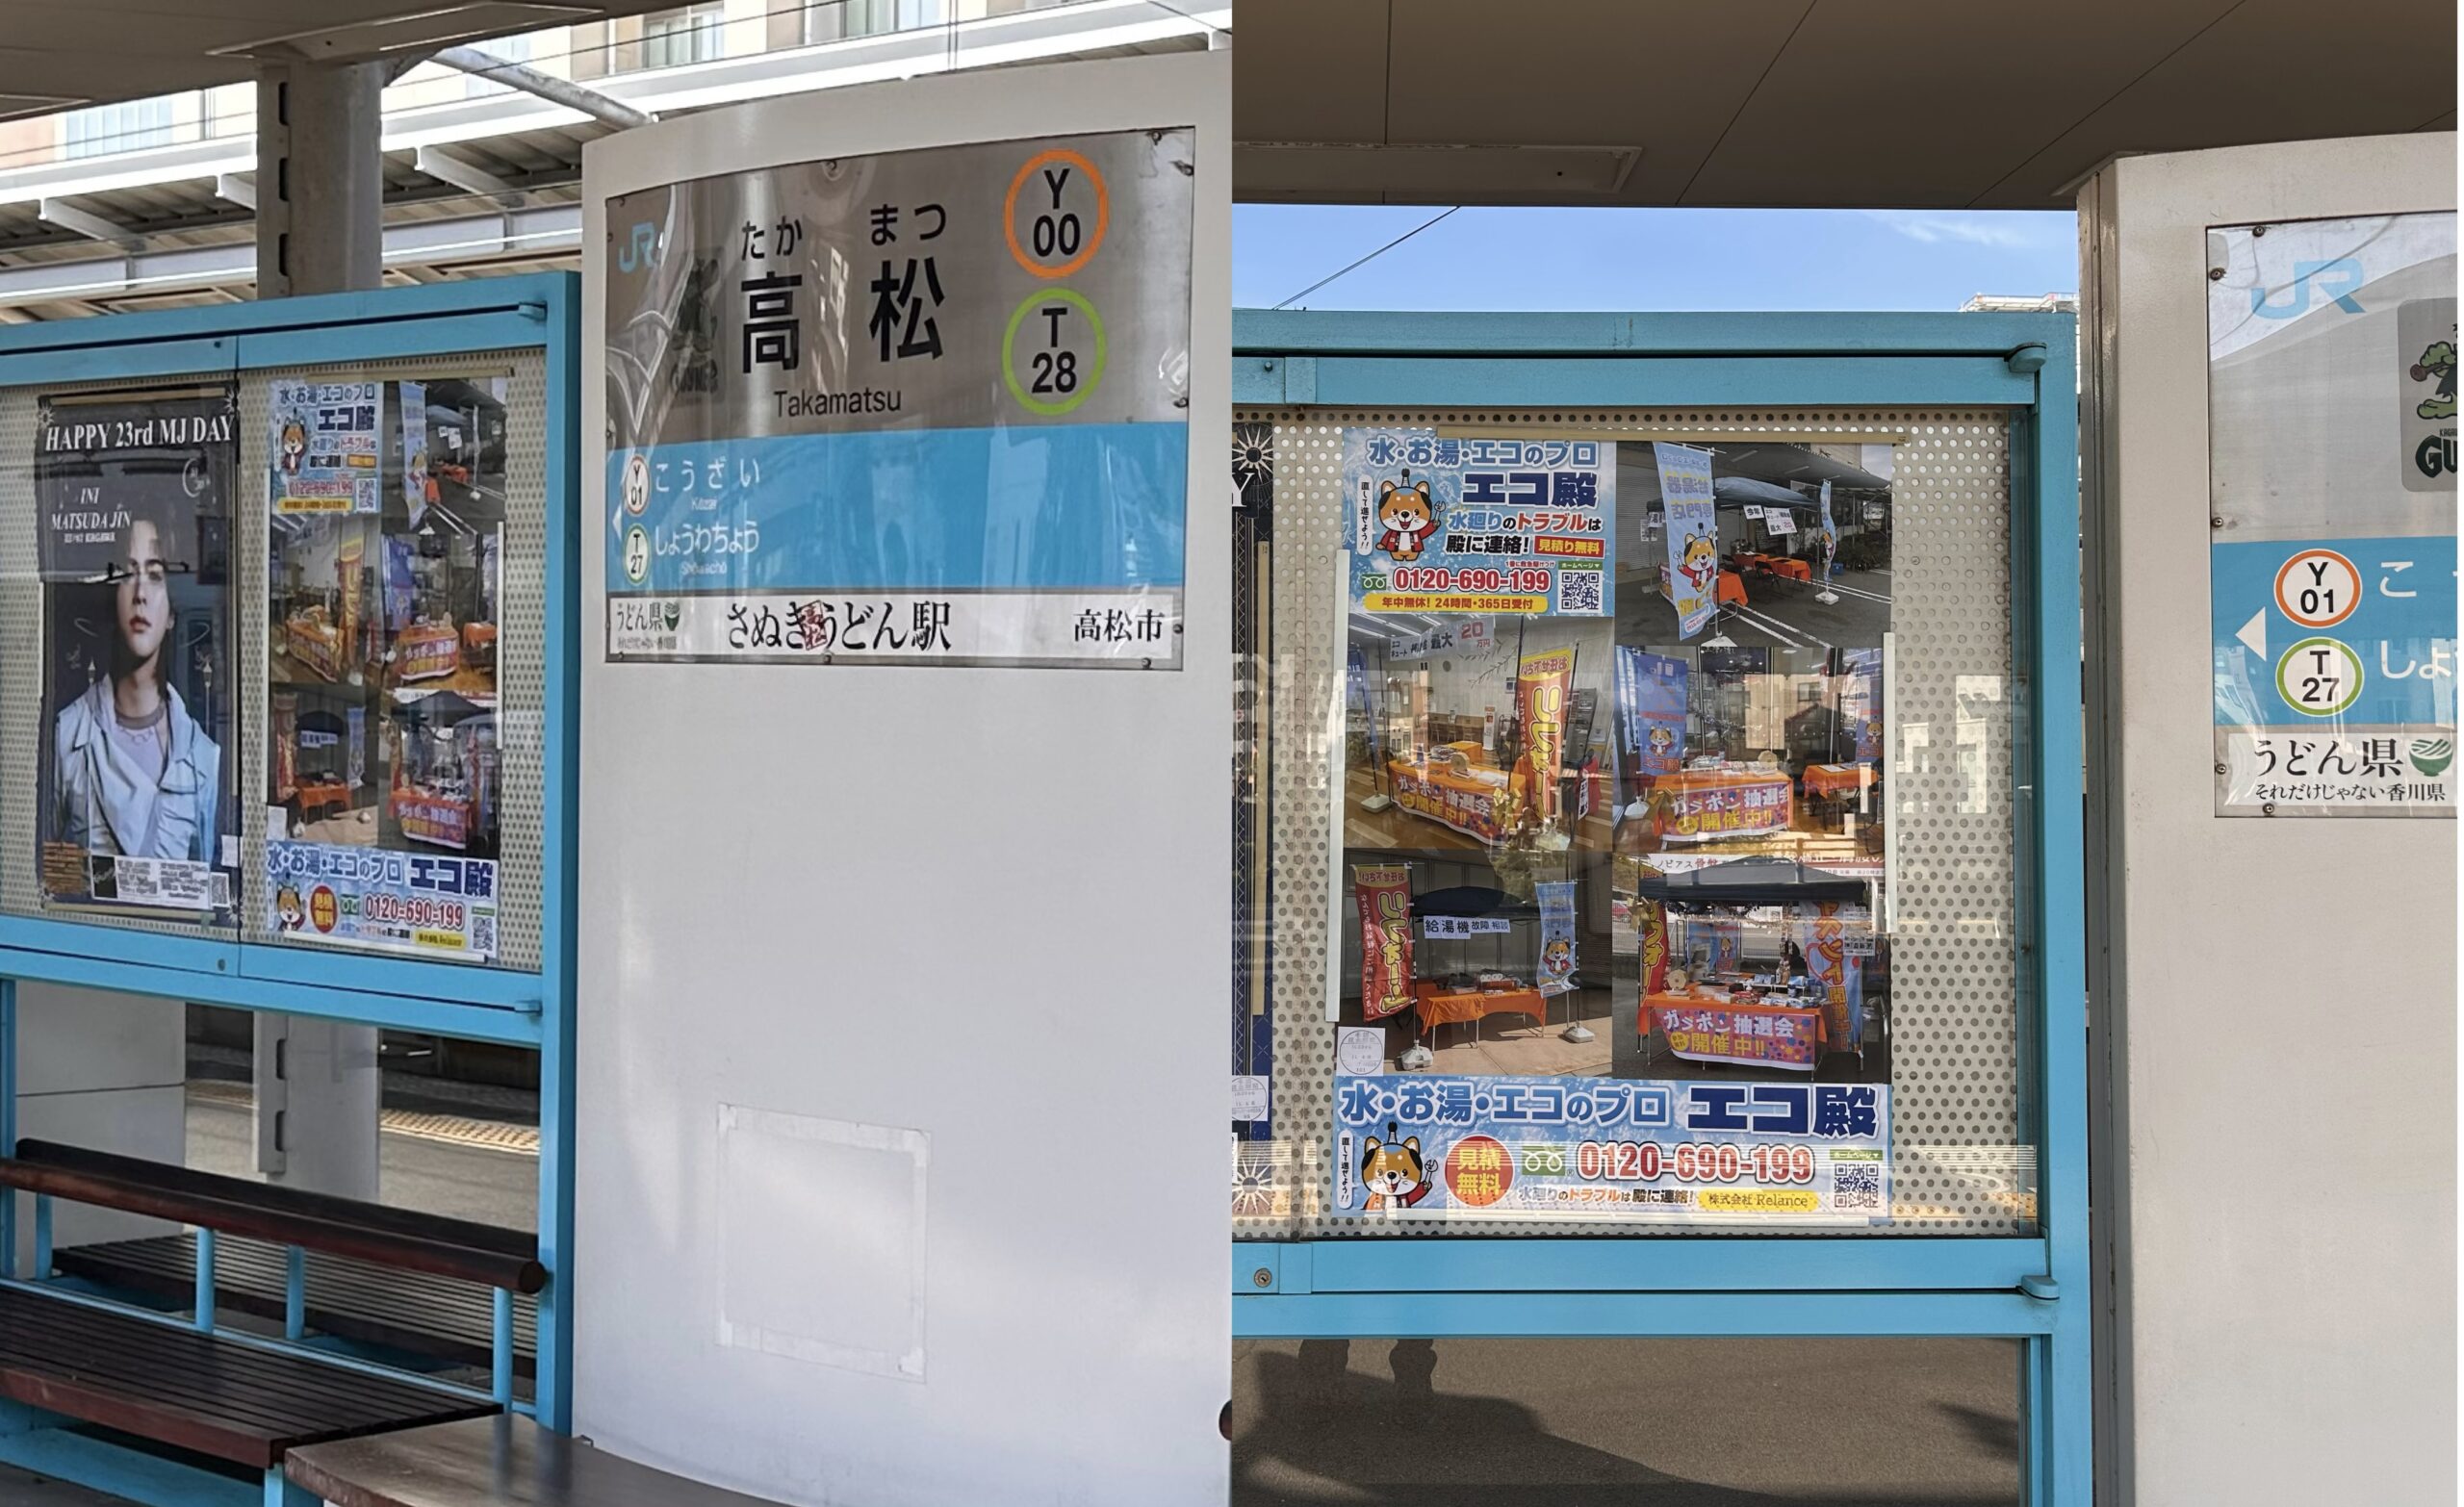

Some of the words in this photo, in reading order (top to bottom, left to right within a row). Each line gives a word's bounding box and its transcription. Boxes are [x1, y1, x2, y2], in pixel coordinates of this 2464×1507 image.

[1044, 169, 1070, 210] Y
[619, 221, 657, 273] JR
[1033, 214, 1080, 257] 00
[2250, 260, 2368, 319] JR
[1042, 308, 1067, 347] T
[1031, 352, 1077, 394] 28
[774, 387, 901, 418] Takamatsu
[45, 423, 112, 450] HAPPY
[116, 420, 153, 447] 23rd
[159, 418, 188, 445] MJ
[192, 414, 235, 443] DAY
[1368, 437, 1599, 467] 水・お湯・エコのプロ
[81, 487, 100, 504] INI
[631, 487, 643, 505] 01
[1463, 472, 1598, 508] エコ殿
[52, 512, 107, 530] MATSUDA
[1448, 512, 1602, 531] 水廻りのトラブルは
[633, 534, 641, 553] T
[1446, 535, 1529, 555] 殿に連絡!
[1538, 538, 1600, 555] 見積り無料
[631, 555, 643, 575] 27
[1395, 568, 1552, 591] 0120-690-199
[2308, 562, 2328, 586] Y
[2300, 589, 2334, 614] 01
[617, 602, 662, 631] うどん県
[1073, 608, 1164, 644] 高松市
[2310, 651, 2330, 675] T
[2302, 677, 2339, 702] 27
[2254, 738, 2404, 778] うどん県
[2255, 783, 2446, 801] それだけじゃない香川県
[410, 858, 493, 897] エコ殿
[365, 894, 464, 929] 0120-690-199
[1341, 1082, 1667, 1124] 水・お湯・エコのプロ
[1687, 1086, 1878, 1137] エコ殿
[1578, 1143, 1813, 1184] 0120-690-199
[1708, 1193, 1752, 1205] 株式会社
[1756, 1193, 1808, 1207] Relance
